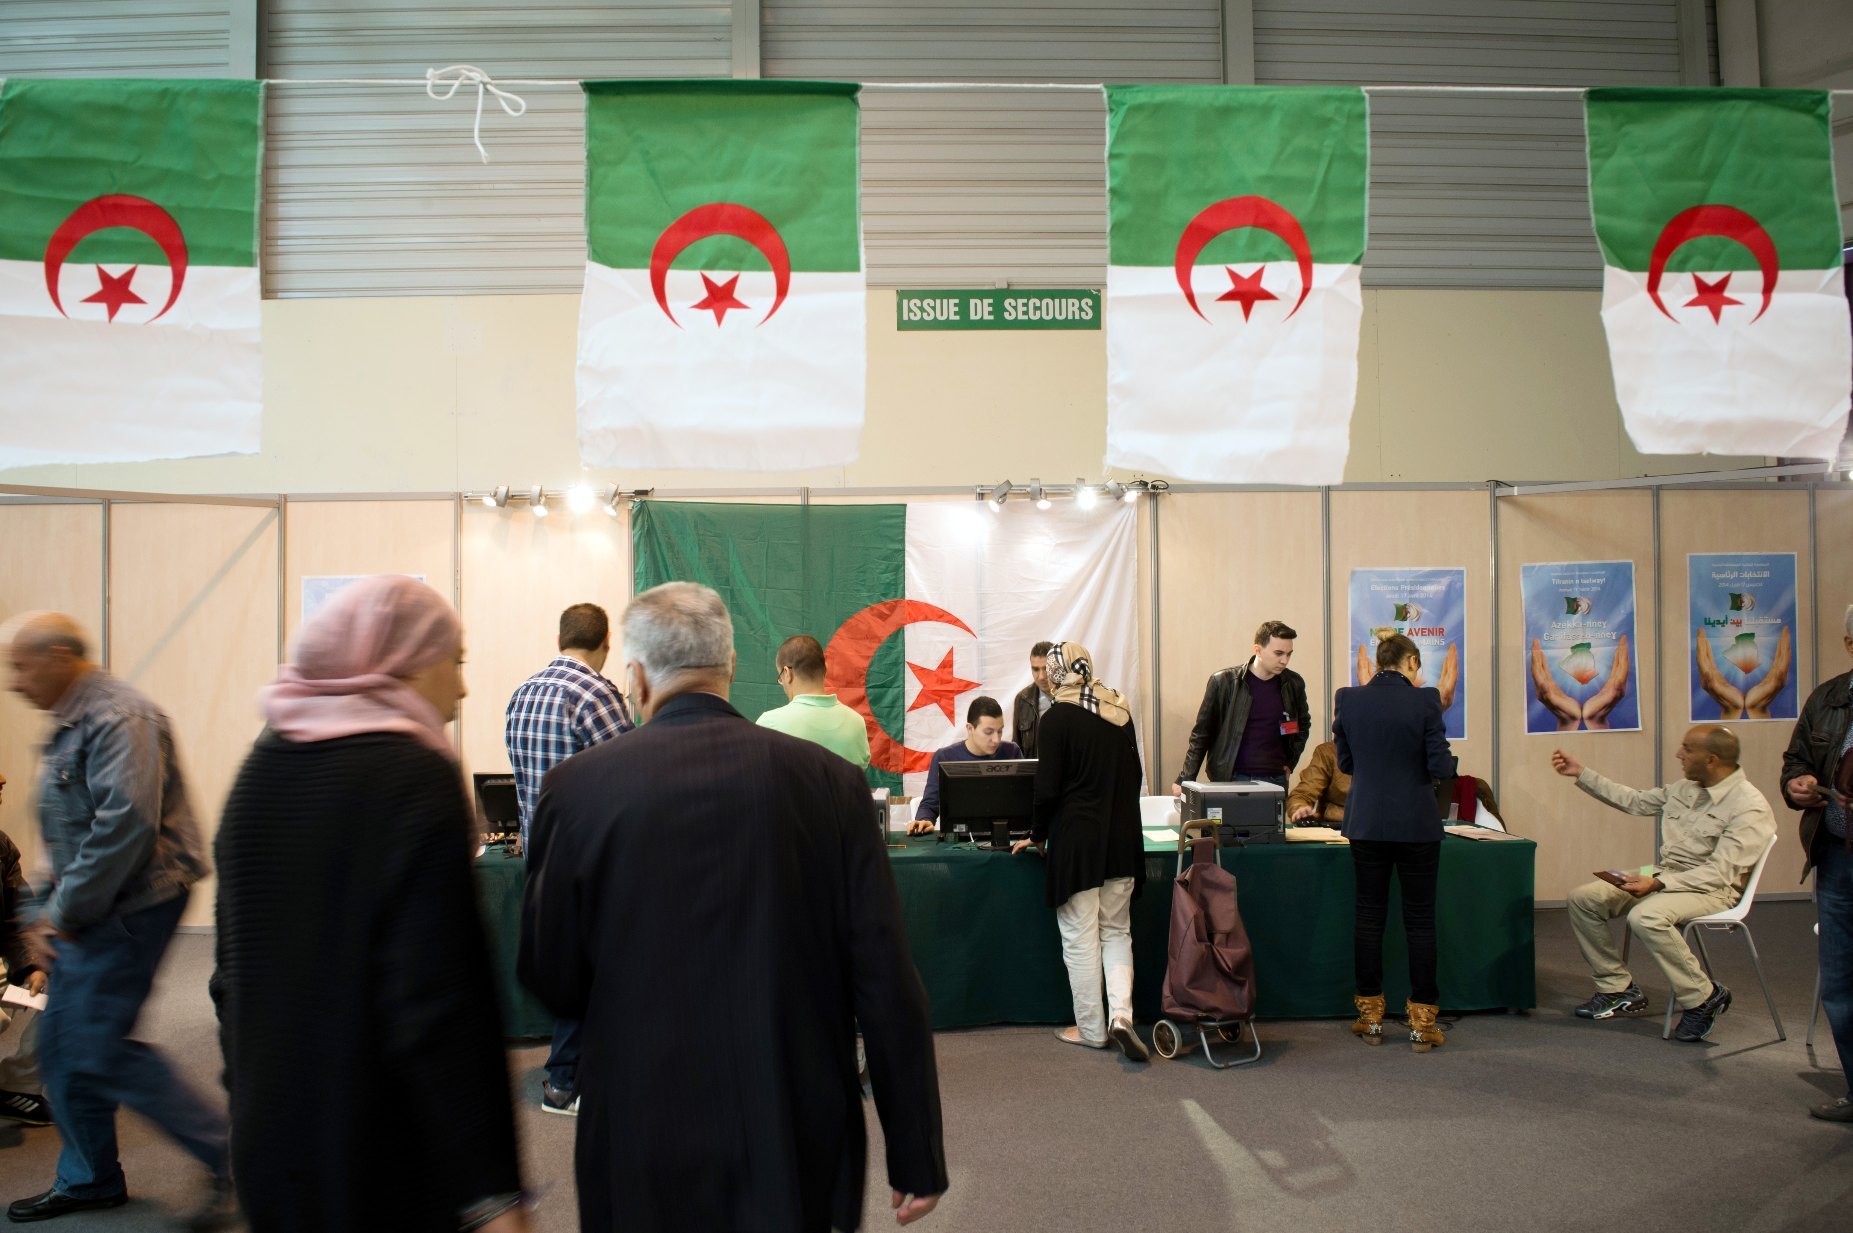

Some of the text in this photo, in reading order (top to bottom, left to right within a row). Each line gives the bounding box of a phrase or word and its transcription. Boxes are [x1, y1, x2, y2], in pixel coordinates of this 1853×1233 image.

[902, 297, 1094, 321] ISSUE DE SECOURS
[1407, 628, 1445, 637] AVENIR
[985, 765, 1012, 773] acer
